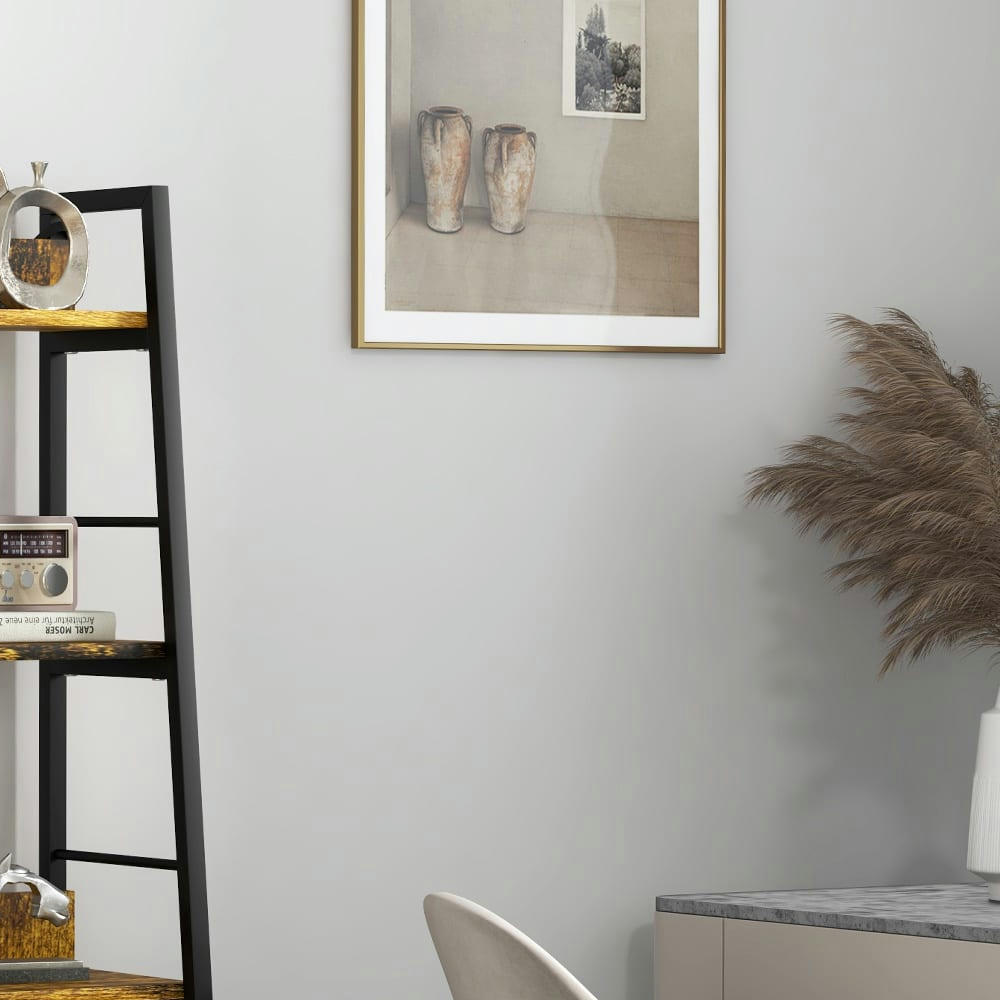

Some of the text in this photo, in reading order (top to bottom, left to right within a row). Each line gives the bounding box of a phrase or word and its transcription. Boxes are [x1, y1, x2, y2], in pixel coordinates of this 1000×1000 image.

[5, 616, 23, 624] neue
[24, 616, 40, 624] eine
[55, 616, 95, 625] Architektur
[46, 625, 95, 634] CARL MOSER
